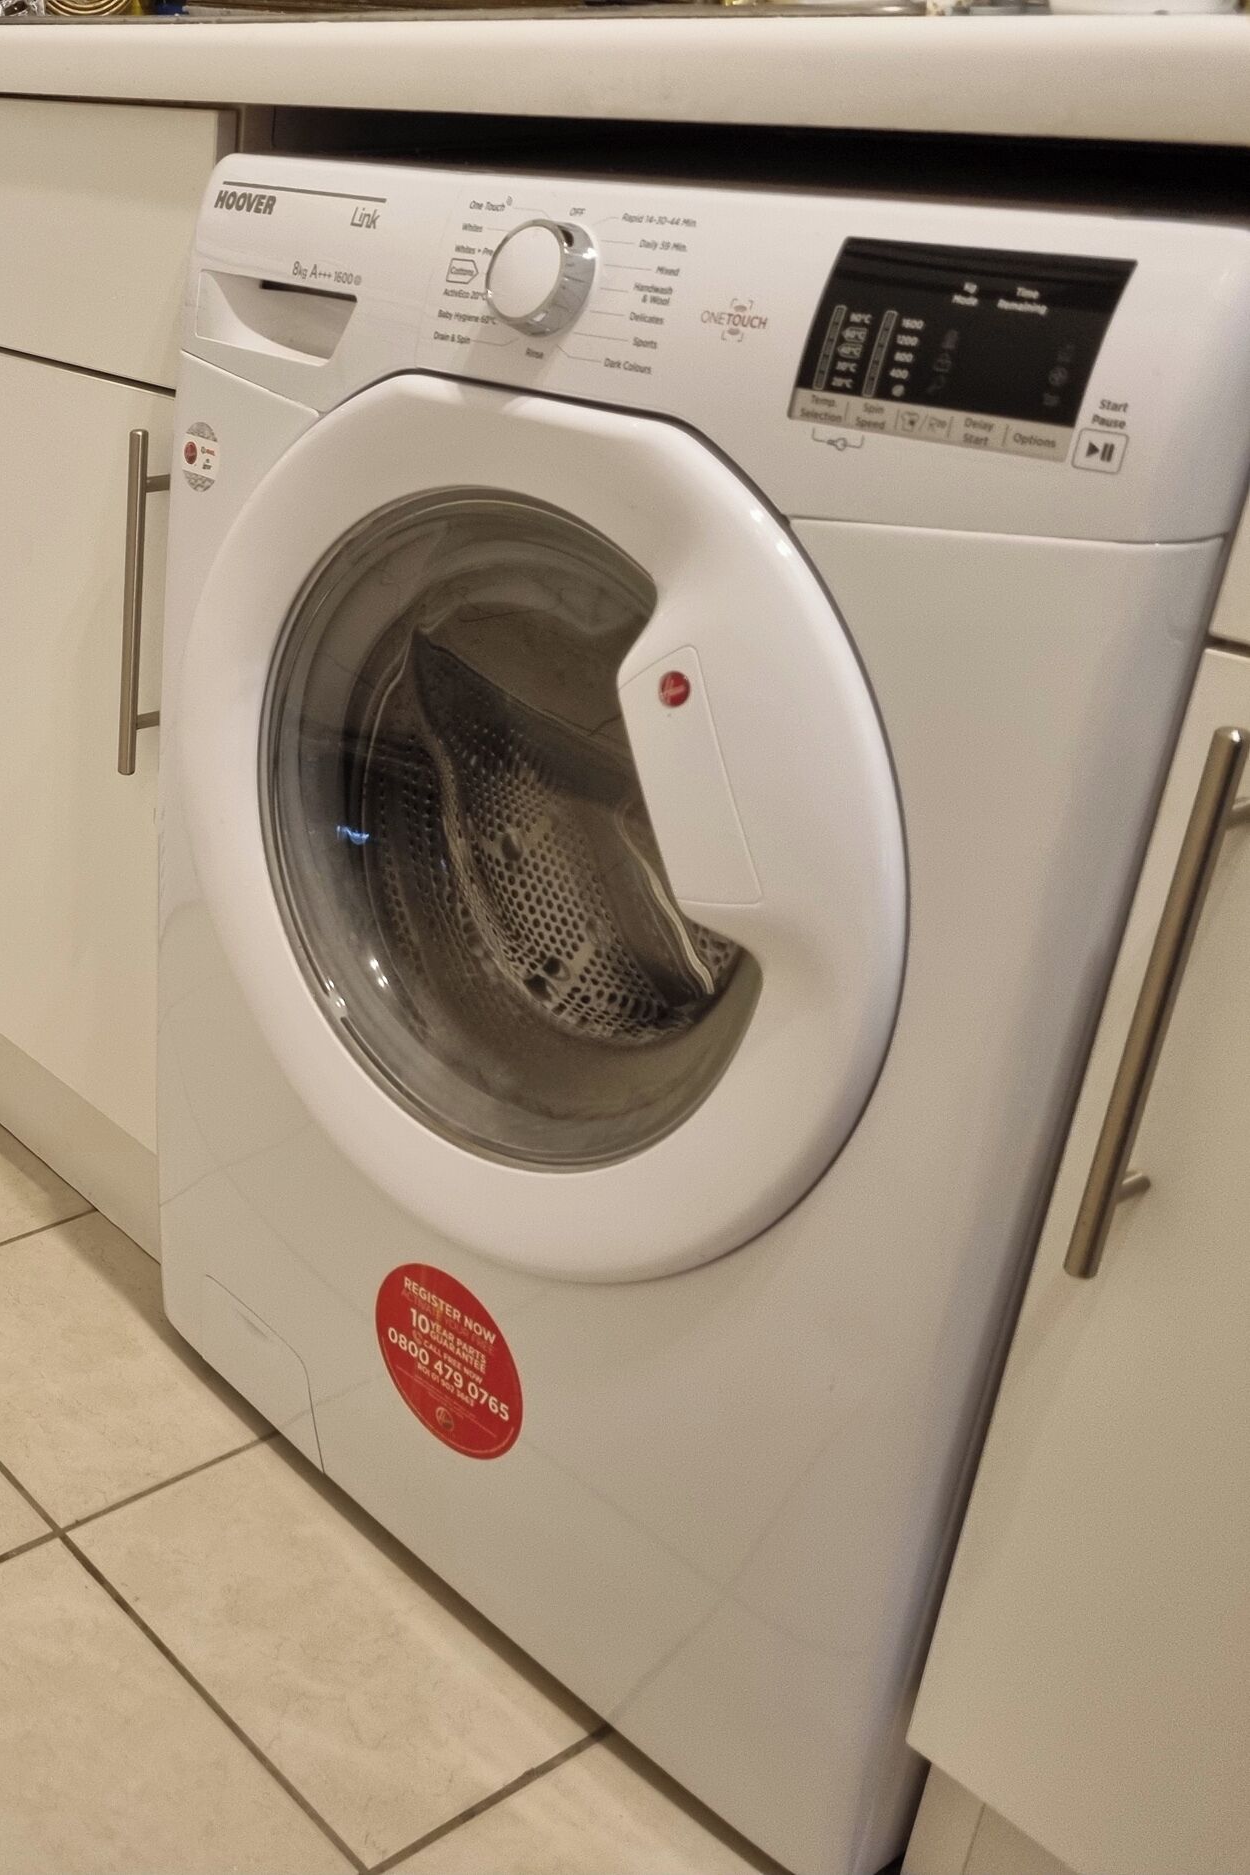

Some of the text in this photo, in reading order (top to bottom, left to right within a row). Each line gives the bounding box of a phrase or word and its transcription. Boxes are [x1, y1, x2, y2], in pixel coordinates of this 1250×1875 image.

[214, 190, 277, 215] HOOVER
[469, 200, 506, 212] One Touch
[350, 206, 381, 229] Link
[569, 208, 586, 216] OFF
[621, 213, 643, 224] Rapid
[639, 239, 658, 251] Daily
[292, 261, 308, 279] 8kg
[309, 264, 332, 279] A+++
[655, 266, 680, 277] Mixed
[634, 282, 673, 294] Handwash
[641, 294, 670, 306] & Wool
[997, 299, 1048, 316] Remaining
[438, 309, 453, 320] Baby
[454, 311, 479, 323] Hygiene
[629, 312, 664, 325] Delicates
[457, 334, 471, 345] Spin
[632, 337, 658, 350] Sports
[604, 358, 652, 375] Dark Colours
[863, 403, 884, 414] Spin
[1099, 399, 1129, 412] Start
[800, 408, 842, 423] Selection
[1092, 414, 1126, 429] Pause
[856, 417, 886, 430] Speed
[965, 418, 994, 432] Delay
[963, 433, 989, 446] Start
[1013, 433, 1056, 448] Options
[404, 1276, 496, 1345] REGISTER NOW
[410, 1308, 487, 1361] 10 YEAR PARTS
[430, 1330, 487, 1374] GUARANTEE
[423, 1341, 483, 1385] CALL FREE NOW
[388, 1327, 429, 1366] 0800
[434, 1360, 463, 1388] 479
[467, 1384, 509, 1421] 0765
